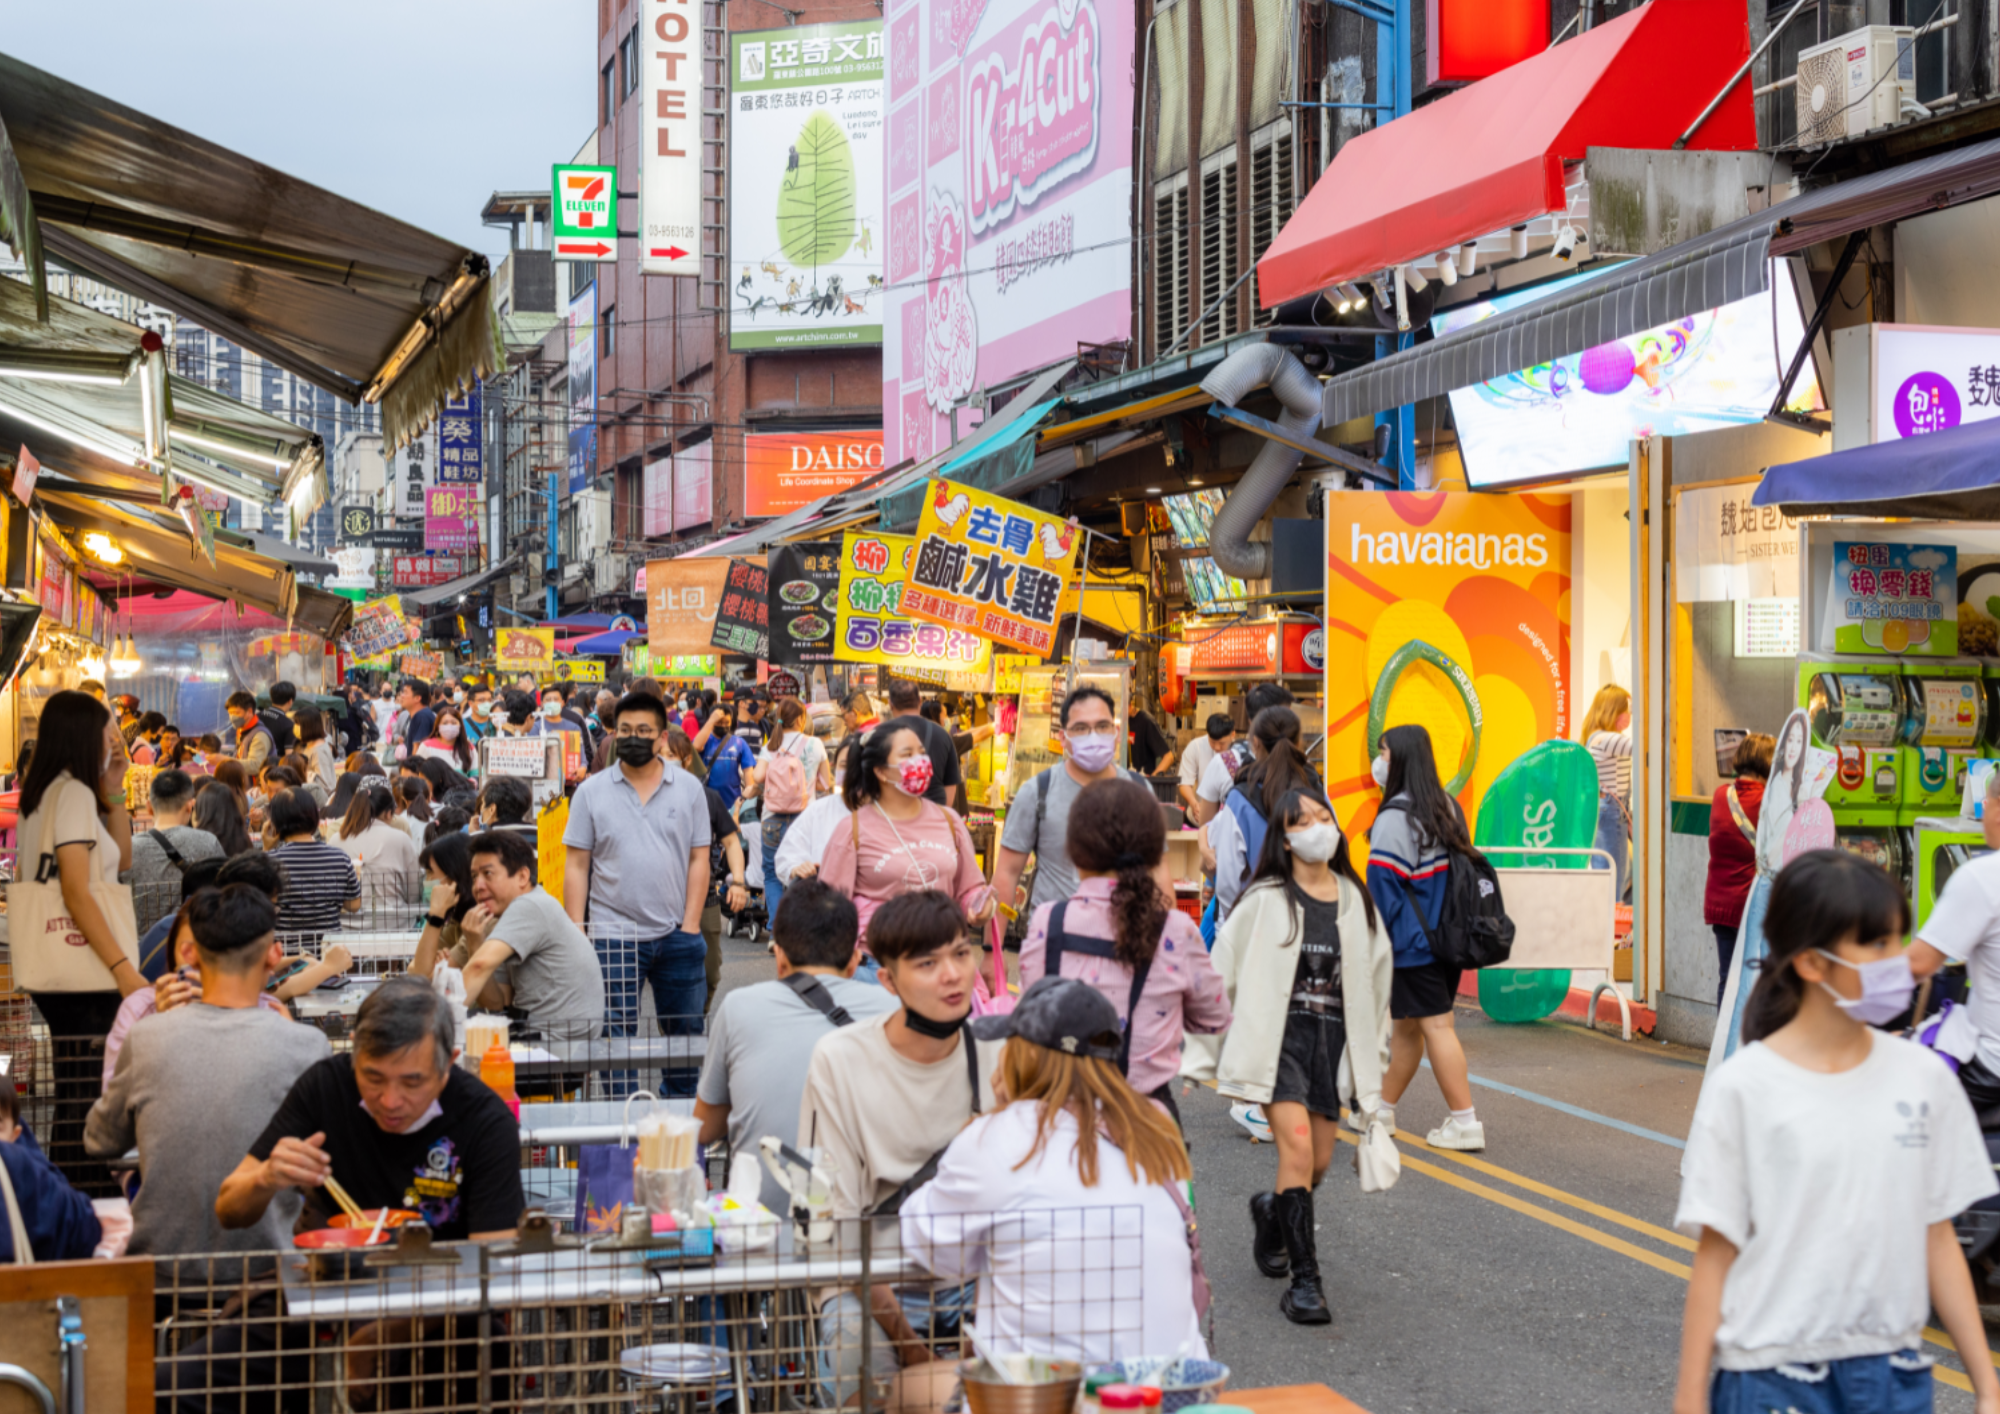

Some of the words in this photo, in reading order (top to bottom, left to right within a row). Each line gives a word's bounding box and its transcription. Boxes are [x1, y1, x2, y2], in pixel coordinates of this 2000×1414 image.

[654, 0, 690, 157] OTEL
[790, 443, 885, 472] DAISO
[780, 477, 794, 487] Life
[836, 476, 855, 487] Shop
[966, 506, 1036, 557] 去骨
[1351, 523, 1549, 569] havaianas
[1750, 541, 1780, 558] SISTER
[913, 534, 1062, 626] 鹹水雞
[1849, 567, 1935, 600] 換零錢
[846, 618, 981, 662] 百香果汁
[1518, 622, 1555, 662] designed
[1549, 661, 1561, 678] for
[1556, 690, 1566, 713] free
[1556, 715, 1566, 733] life
